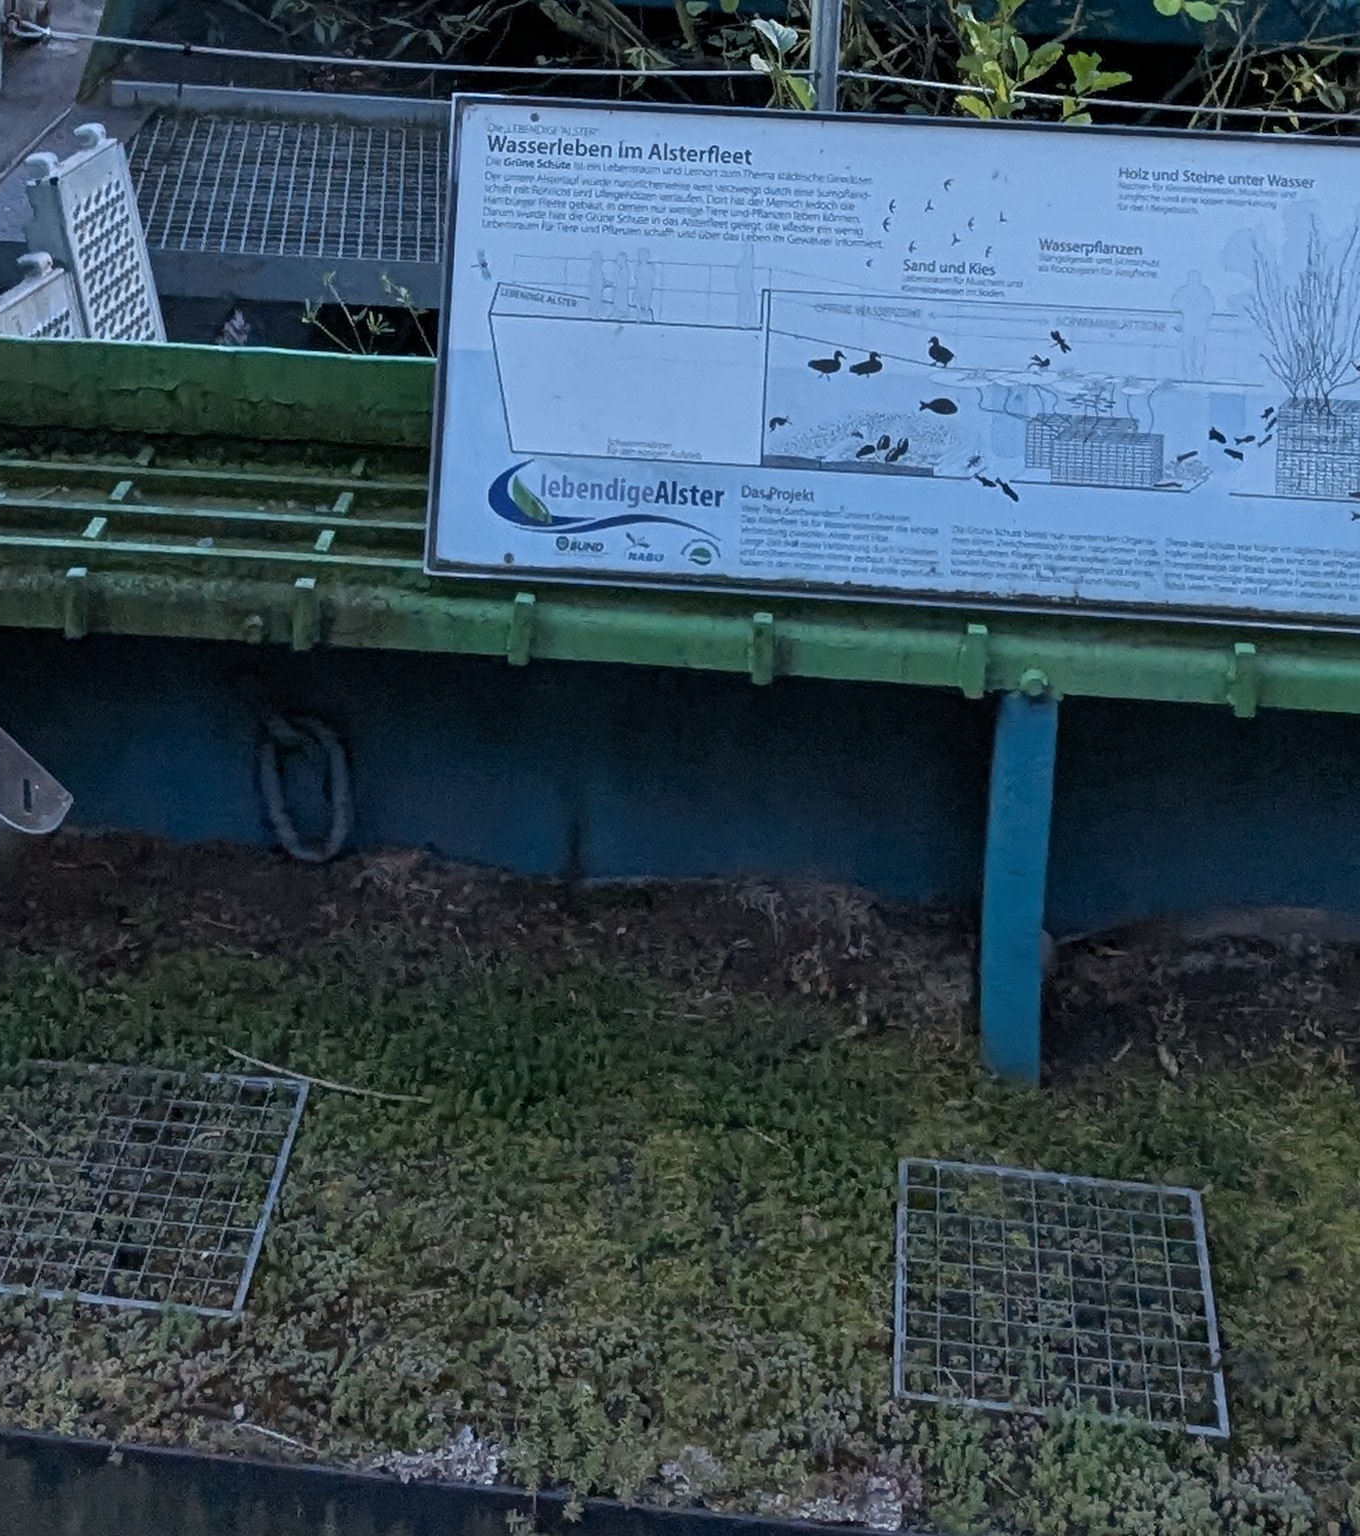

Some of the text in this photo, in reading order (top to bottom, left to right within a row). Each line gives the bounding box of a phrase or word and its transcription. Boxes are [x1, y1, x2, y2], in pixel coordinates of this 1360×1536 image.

[487, 135, 753, 165] Wasserleben im Alsterfleet
[1118, 167, 1315, 189] Holz und Steine unter Wasser
[1038, 238, 1144, 256] Wasserpflanzen
[902, 259, 996, 276] Sand und Kies
[546, 296, 578, 308] ALSTER
[541, 474, 725, 508] lebendigeAlster
[740, 485, 815, 504] Das Projekt
[569, 541, 604, 553] BUND
